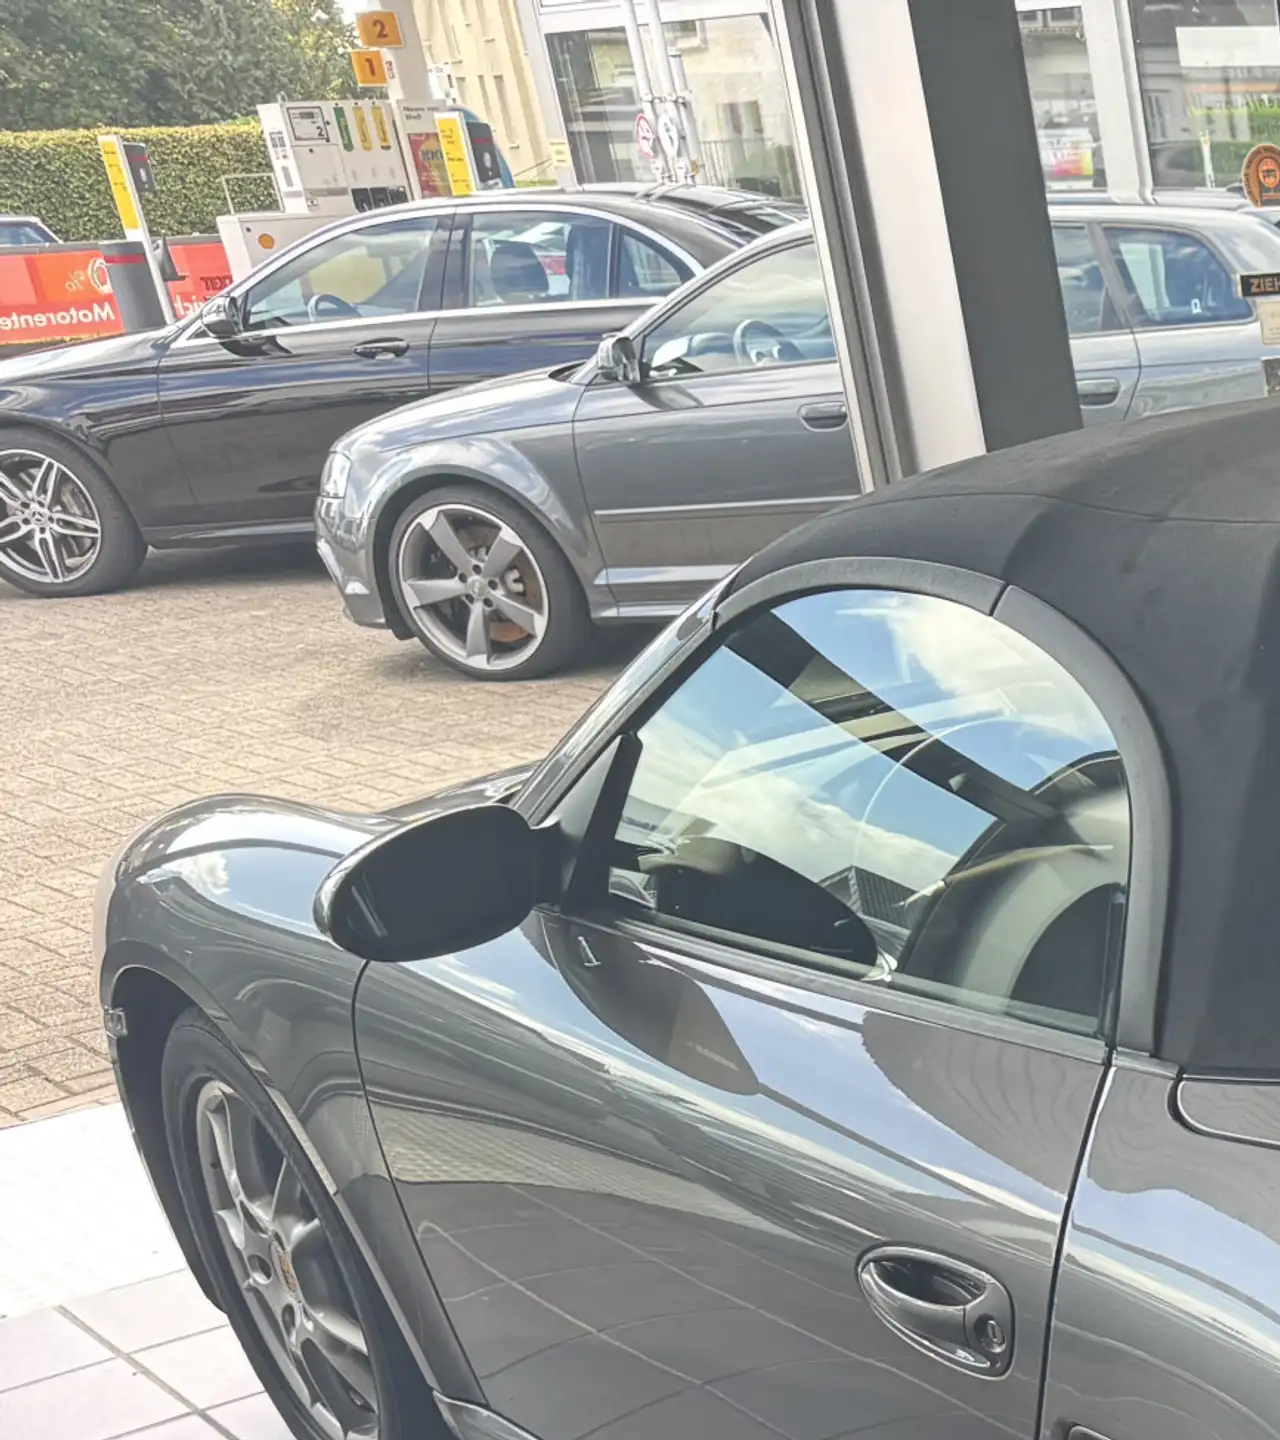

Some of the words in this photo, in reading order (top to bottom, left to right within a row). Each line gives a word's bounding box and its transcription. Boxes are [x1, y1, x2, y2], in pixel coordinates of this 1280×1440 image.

[372, 19, 389, 39] 2
[364, 57, 376, 77] 1
[315, 125, 325, 137] 2
